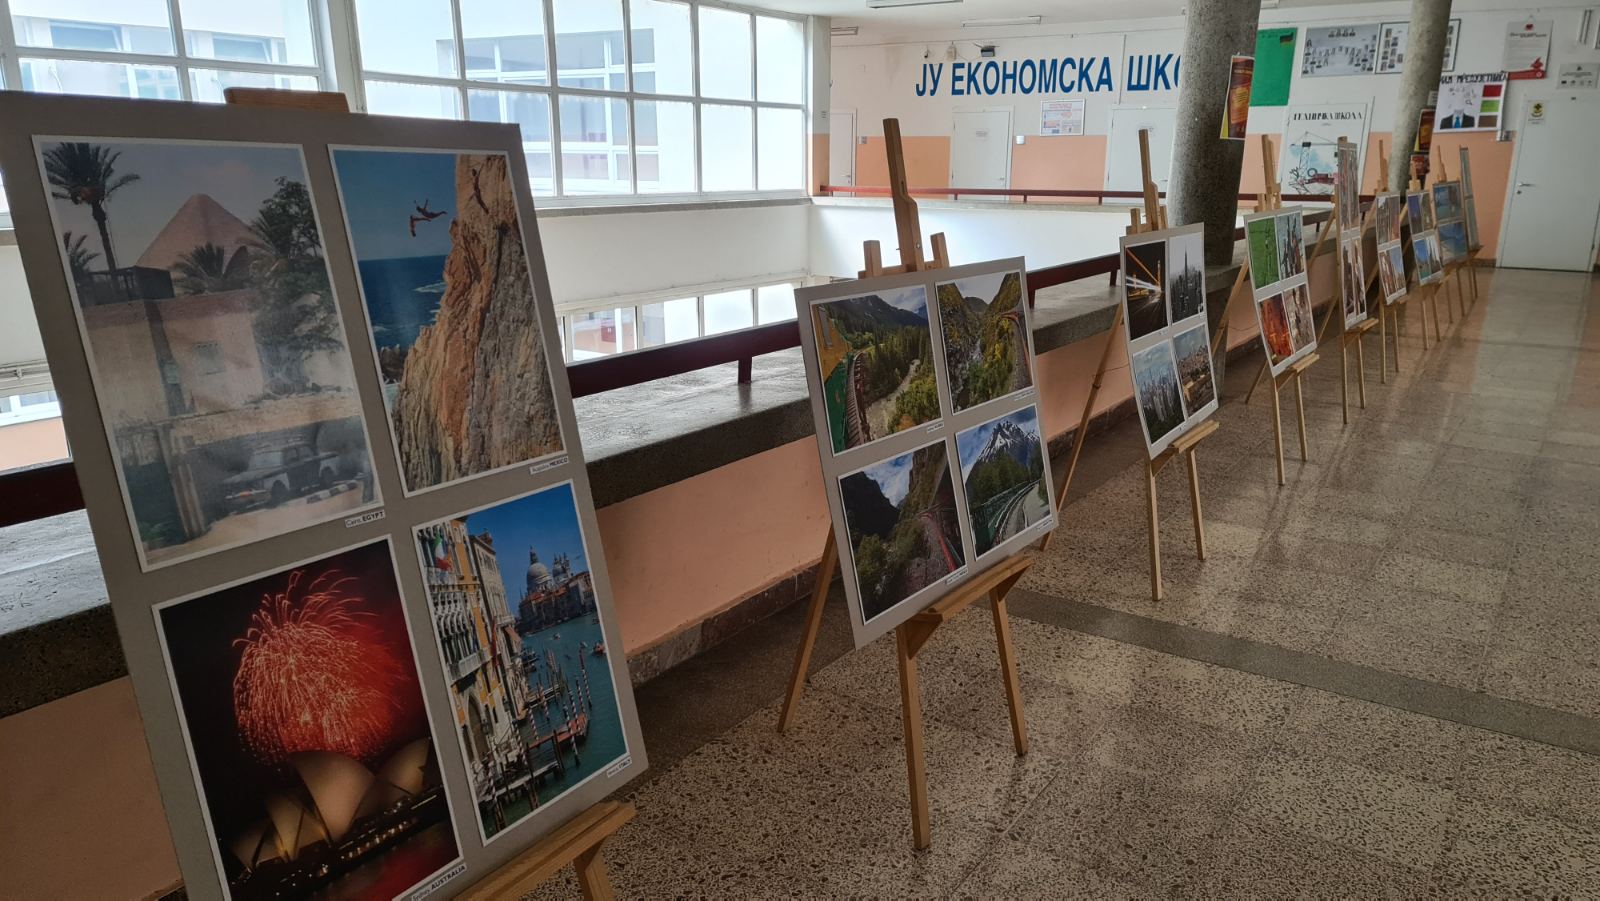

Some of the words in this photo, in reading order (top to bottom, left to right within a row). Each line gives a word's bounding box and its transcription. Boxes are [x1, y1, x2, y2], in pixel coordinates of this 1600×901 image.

[915, 63, 943, 96] ЈУ
[951, 57, 1113, 96] ЕКОНОМСКА
[362, 511, 384, 522] EGYPT
[430, 865, 466, 891] AUSTRALIA
